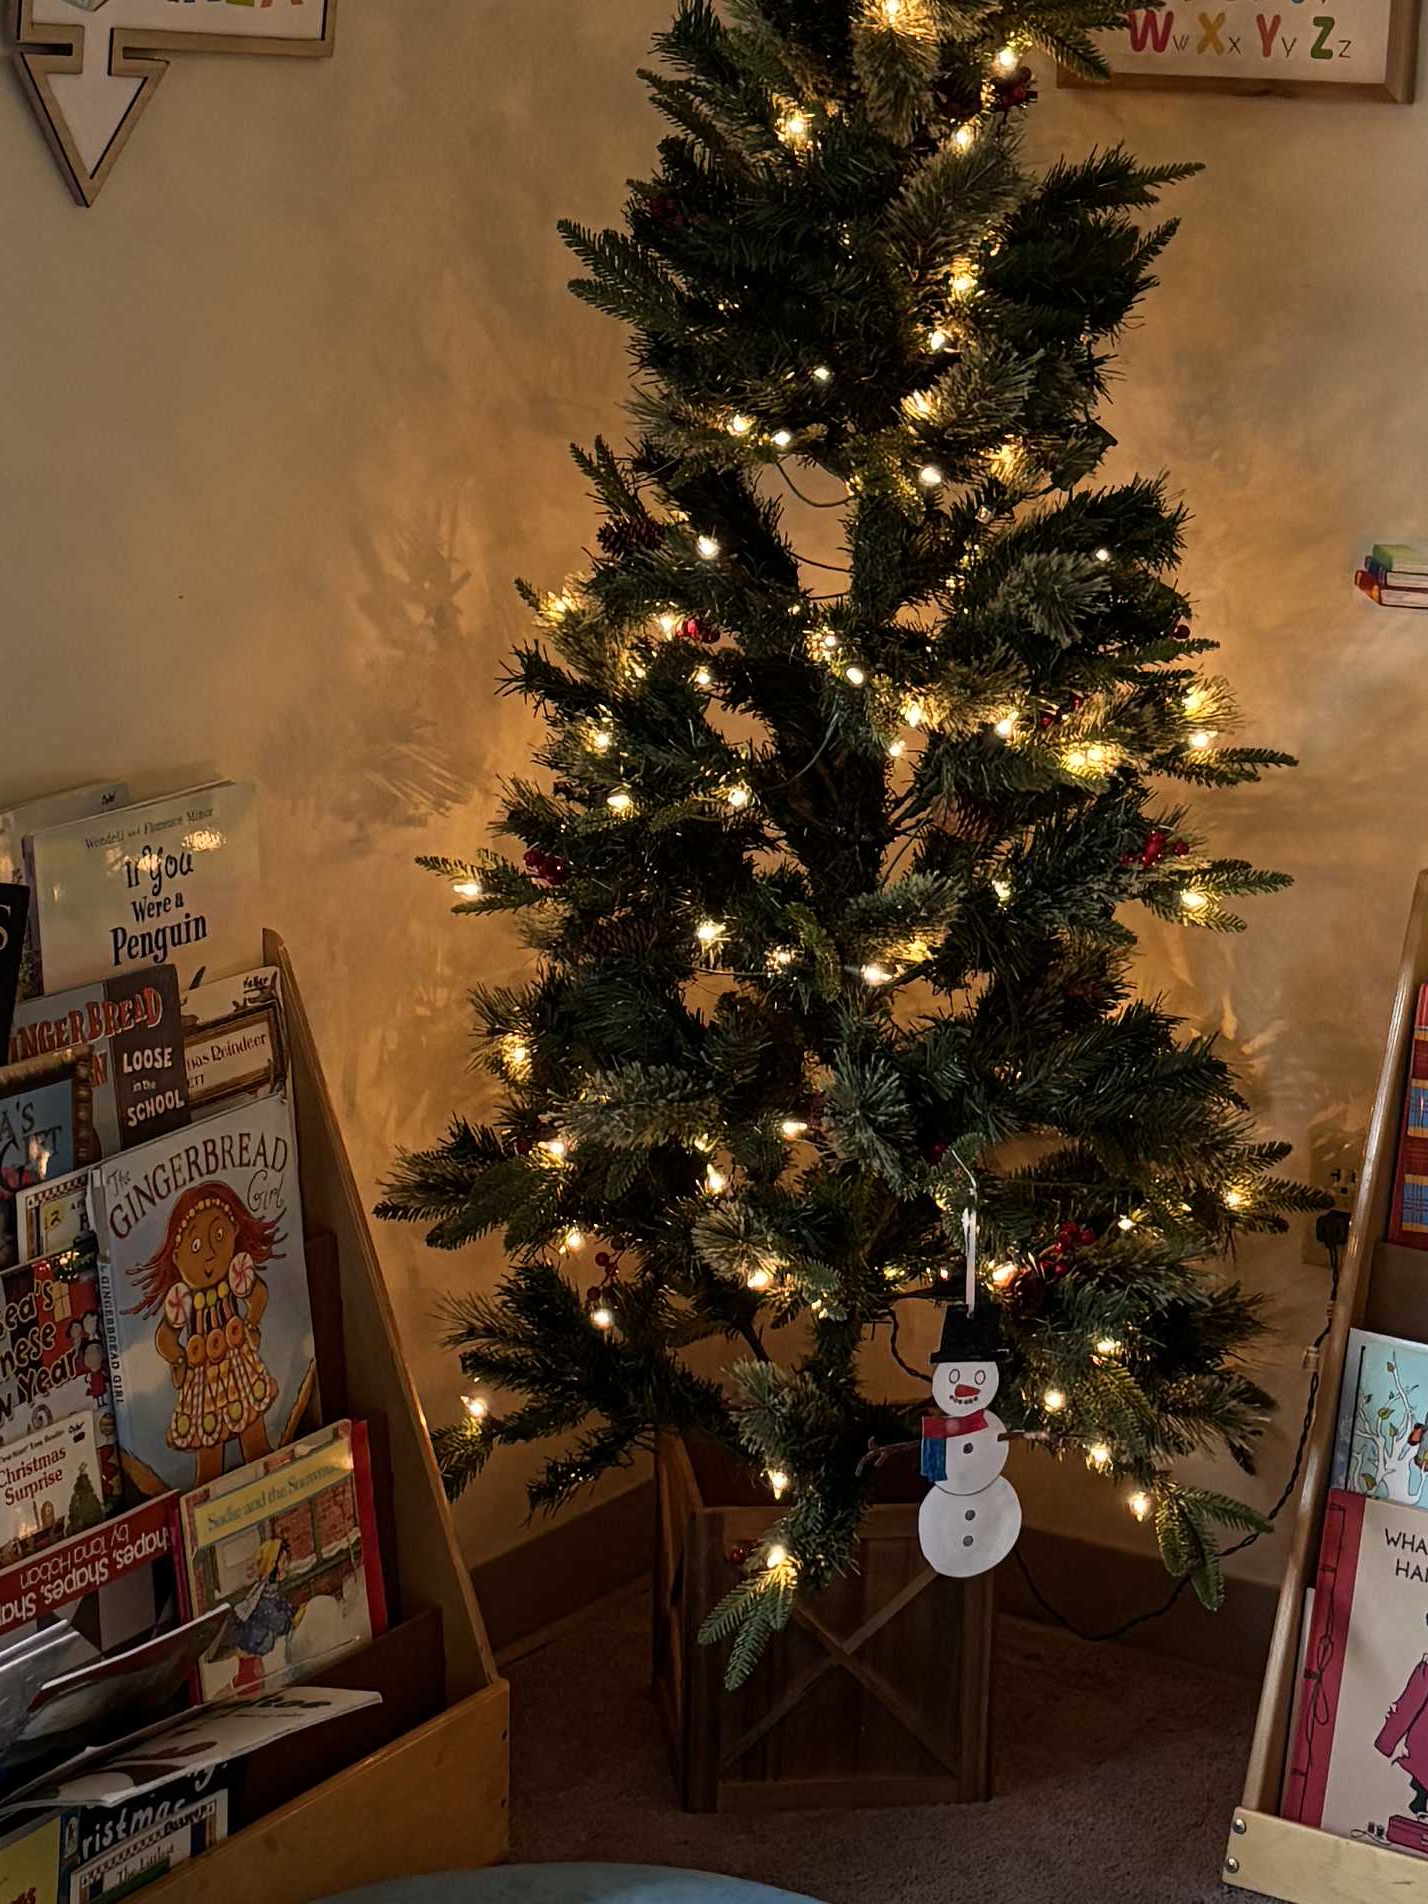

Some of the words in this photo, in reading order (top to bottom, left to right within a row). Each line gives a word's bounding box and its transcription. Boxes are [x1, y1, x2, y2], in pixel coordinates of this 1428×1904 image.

[132, 896, 171, 923] Were
[111, 913, 207, 967] Penguin
[123, 1047, 172, 1074] LOOSE
[127, 1088, 185, 1128] SCHOOL
[108, 1130, 288, 1241] GINGERBREAD
[247, 1167, 286, 1214] Girl
[15, 1348, 79, 1408] Year
[5, 1468, 63, 1507] Surprise
